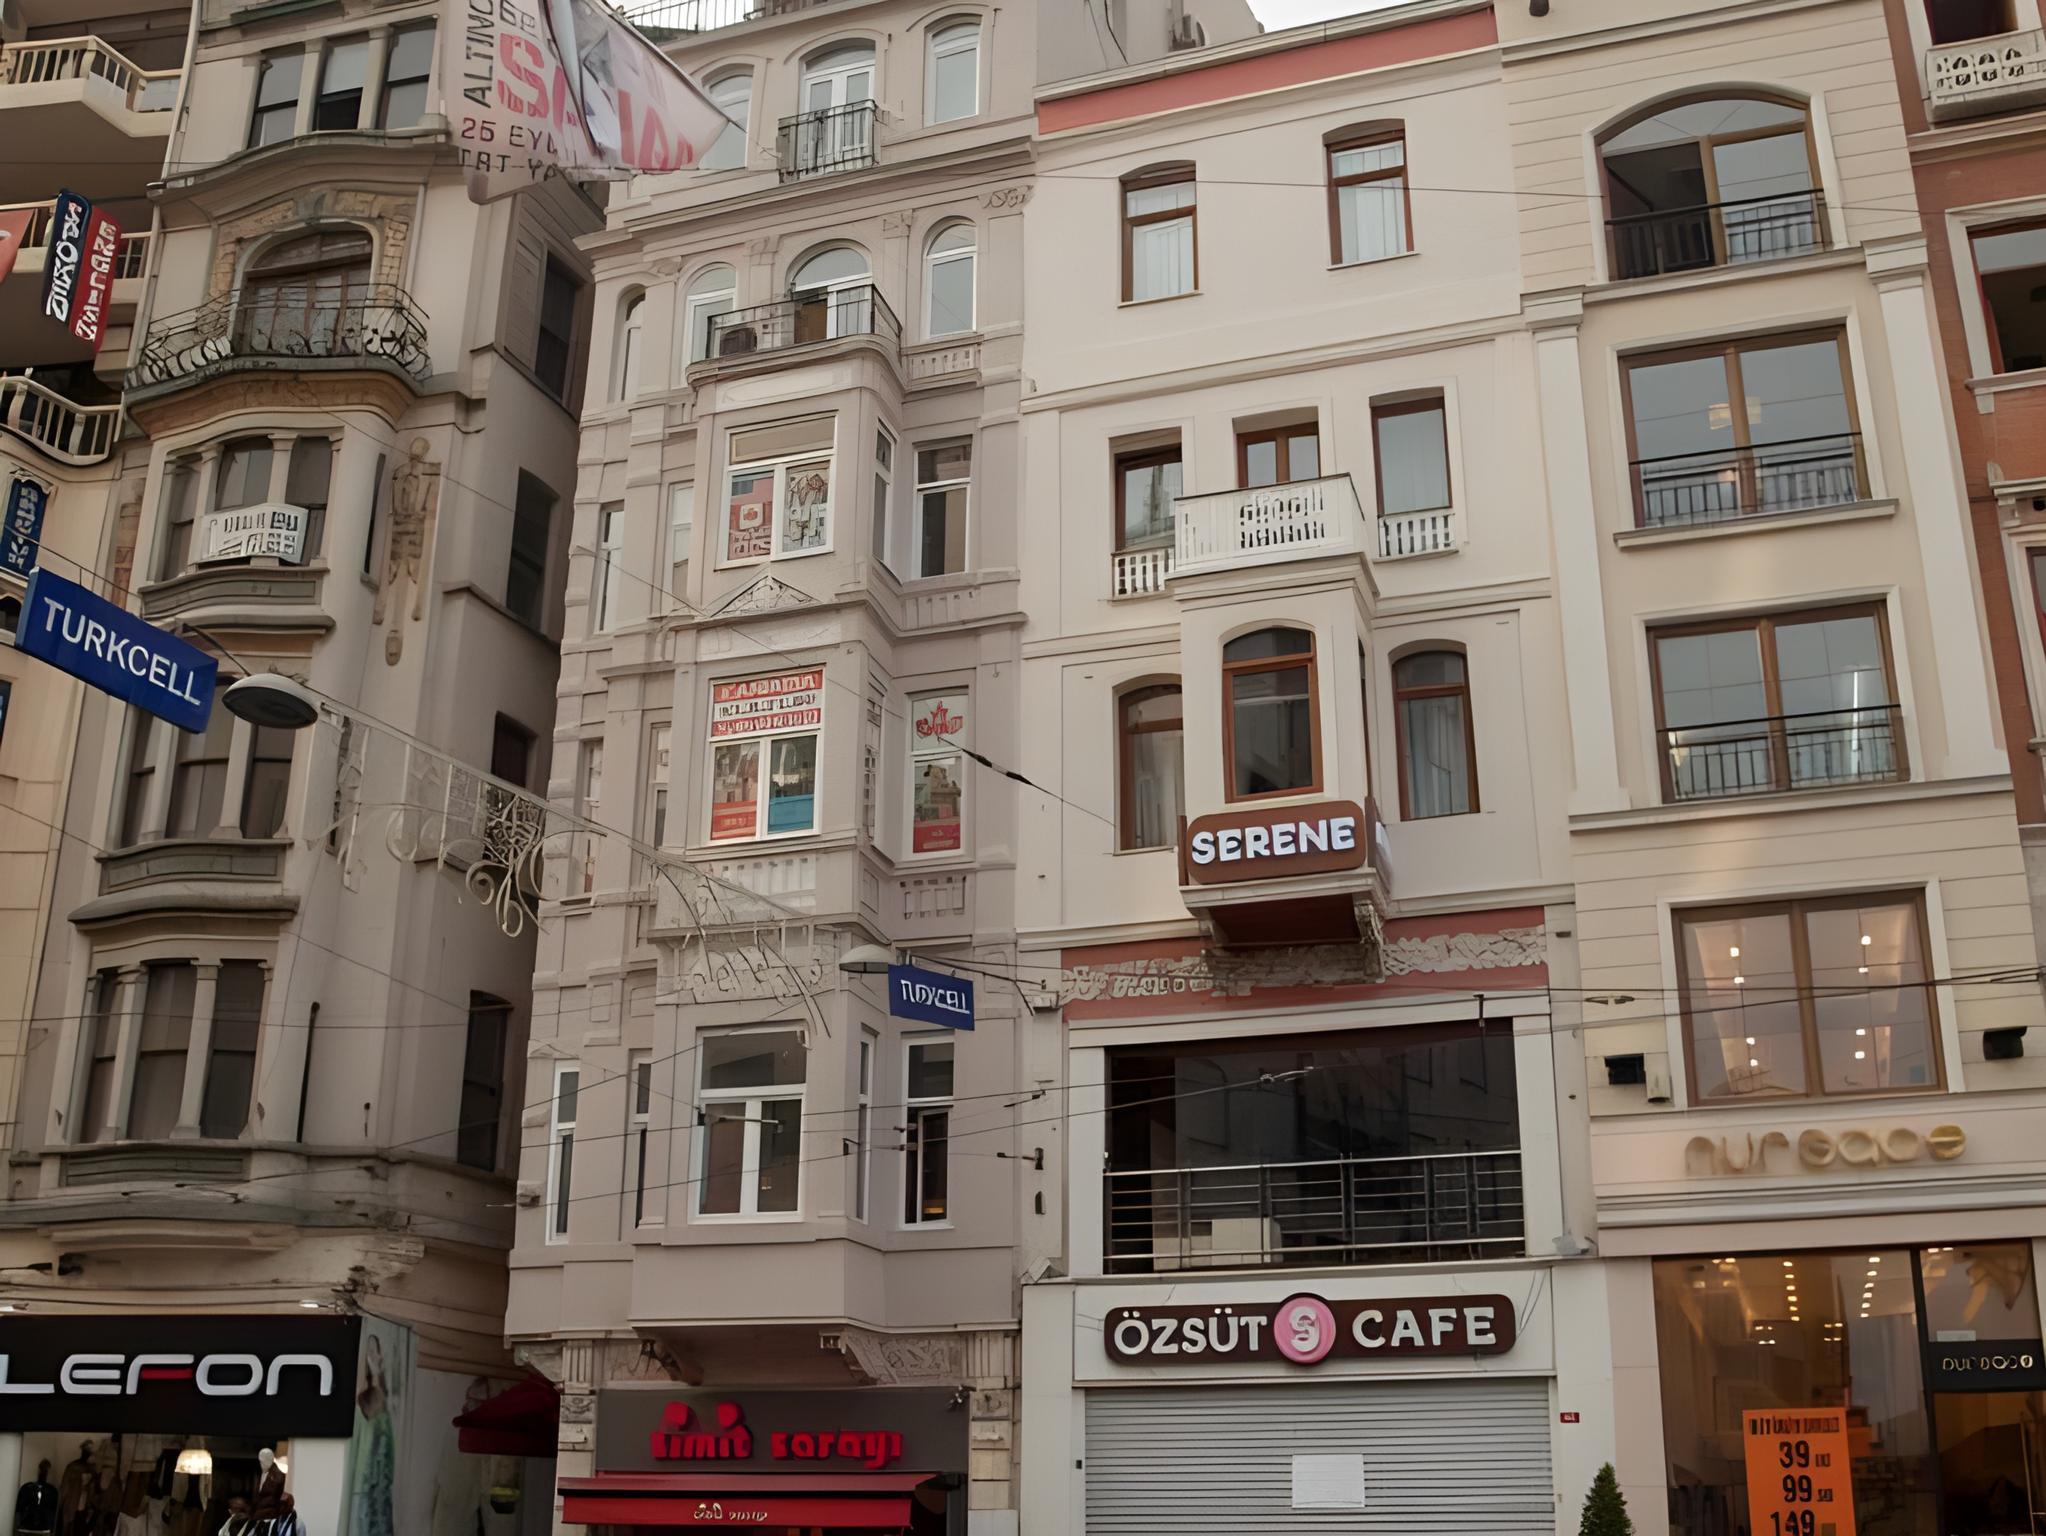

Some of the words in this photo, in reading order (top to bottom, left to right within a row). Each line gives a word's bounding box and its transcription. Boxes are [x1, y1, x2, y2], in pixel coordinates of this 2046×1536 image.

[43, 596, 201, 706] TURKCELL
[1191, 816, 1356, 865] SERENE
[1113, 1307, 1268, 1356] ÖZSÜT
[1351, 1306, 1497, 1349] CAFE
[1779, 1440, 1810, 1468] 39
[1782, 1474, 1812, 1502] 99
